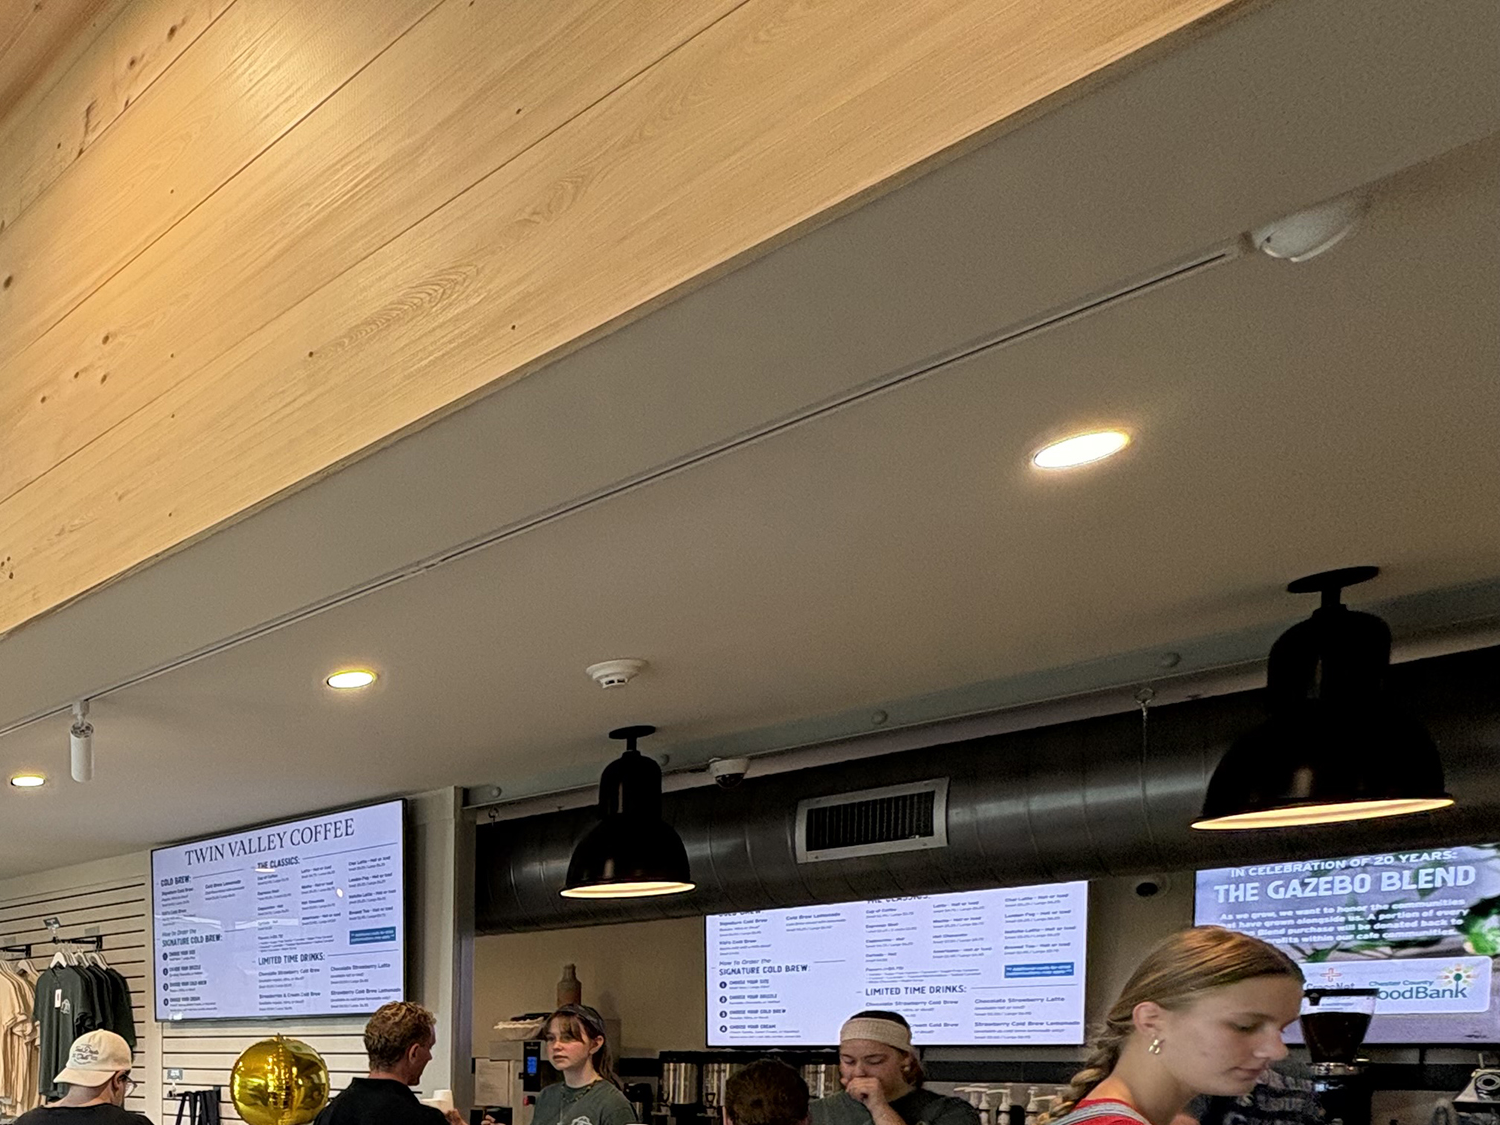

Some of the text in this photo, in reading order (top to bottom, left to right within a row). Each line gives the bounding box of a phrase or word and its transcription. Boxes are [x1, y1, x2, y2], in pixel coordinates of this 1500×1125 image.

[185, 818, 355, 865] TWIN VALLEY COFFEE
[270, 856, 300, 868] CLASSICS:
[1231, 850, 1458, 878] IN CELEBRATION OF 20 YEARS:
[161, 875, 192, 887] COLD BREW:
[1213, 865, 1477, 904] THE GAZEBO BLEND
[1337, 904, 1368, 913] honor
[1370, 903, 1389, 911] the
[1391, 898, 1466, 910] communities
[1239, 920, 1262, 929] have
[1264, 918, 1295, 928] grown
[1296, 915, 1346, 926] alongside
[1366, 913, 1376, 921] A
[1379, 910, 1419, 921] portion
[1421, 910, 1434, 918] of
[1436, 908, 1471, 918] every
[1258, 928, 1286, 937] Blend
[1288, 925, 1335, 936] purchase
[1357, 922, 1371, 930] be
[1373, 920, 1418, 930] donated
[1421, 918, 1448, 927] back
[1450, 918, 1464, 926] to
[162, 934, 223, 947] SIGNATURE COLD BREW:
[1301, 934, 1335, 943] within
[258, 952, 325, 965] LIMITED TIME DRINKS:
[719, 964, 811, 976] SIGNATURE COLD BREW:
[1402, 979, 1435, 987] County
[865, 985, 967, 996] LIMITED TIME DRINKS:
[1376, 986, 1468, 1001] oodBank
